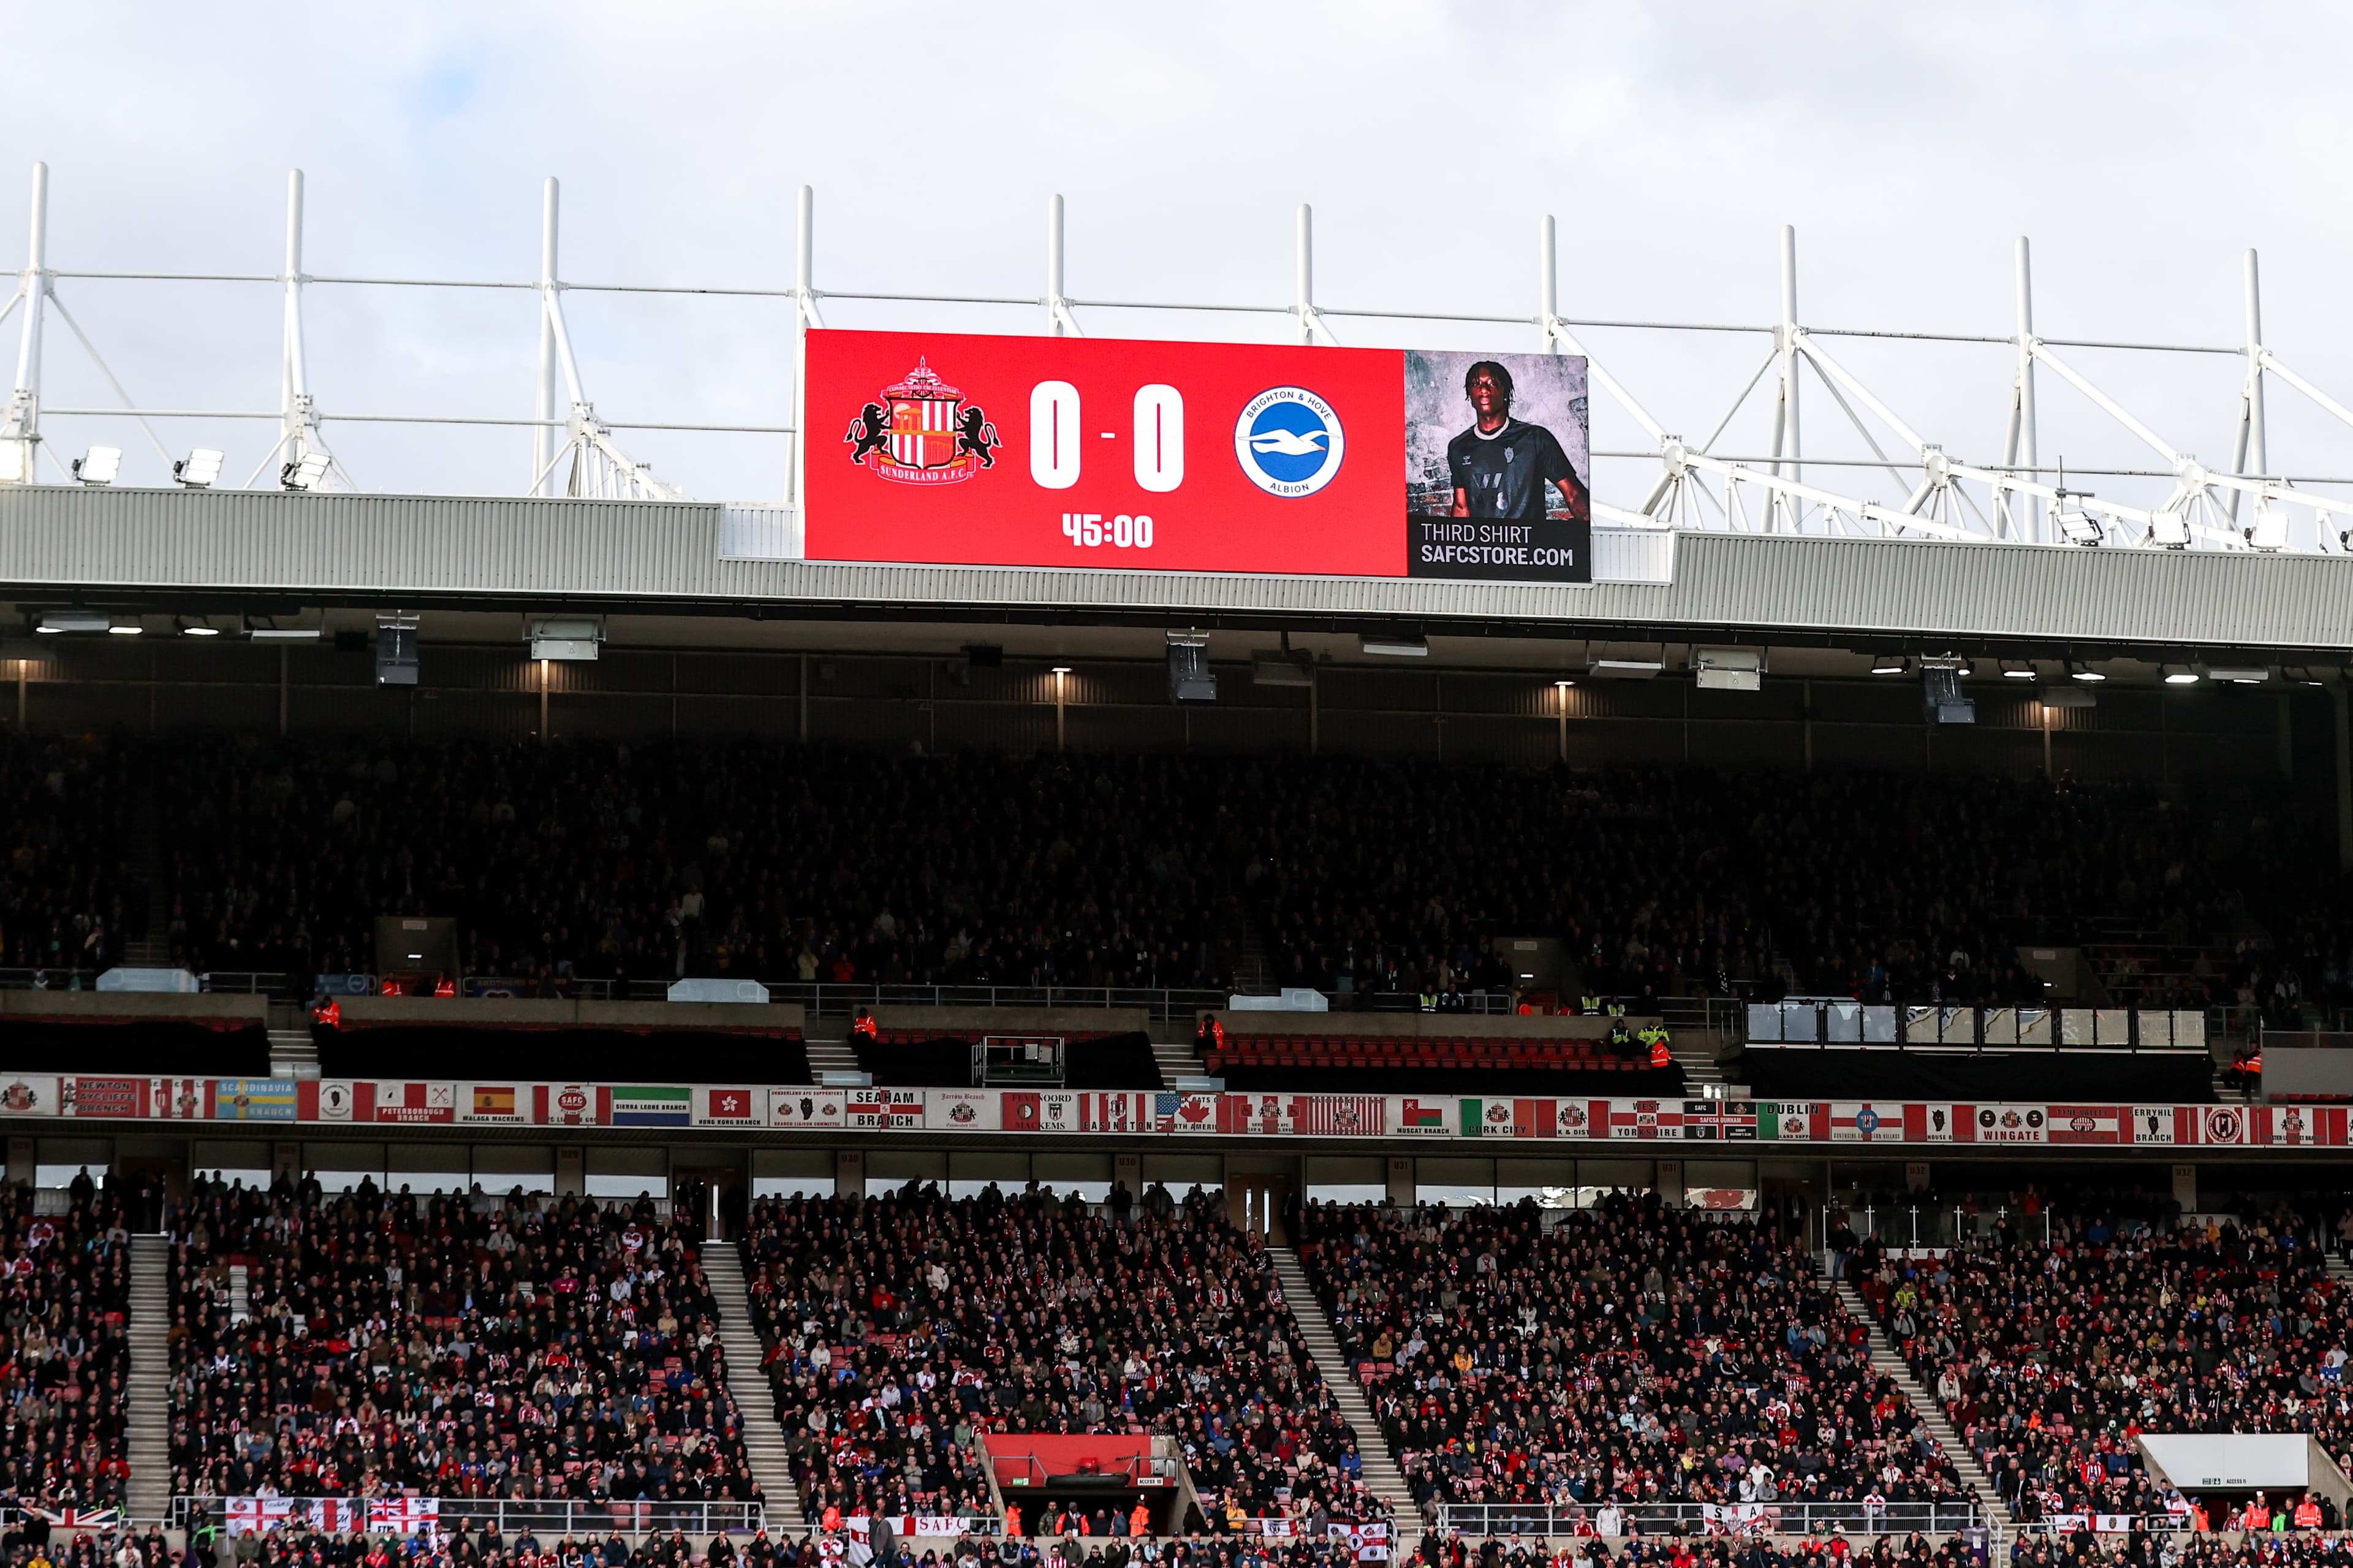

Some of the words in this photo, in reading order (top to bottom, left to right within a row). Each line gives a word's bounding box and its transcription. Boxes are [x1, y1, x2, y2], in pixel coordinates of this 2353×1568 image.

[1246, 391, 1294, 418] BRIGHTON
[1308, 396, 1332, 420] HOVE
[1029, 381, 1081, 490] 0
[1134, 383, 1184, 493] 0
[881, 464, 939, 481] SUNDERLAND
[942, 468, 966, 481] A.F.C.
[1270, 482, 1309, 493] ALBION
[1062, 513, 1153, 548] 45:00
[1421, 523, 1475, 542] THIRD
[1480, 525, 1532, 543] SHIRT
[1421, 545, 1574, 566] SAFCSTORE.COM
[79, 1081, 130, 1090] NEWTON
[222, 1082, 292, 1092] SCANDINAVIA
[79, 1093, 135, 1102] AYCLIFFE
[856, 1092, 914, 1103] SEAHAM
[78, 1104, 128, 1113] BRANCH
[1767, 1105, 1819, 1115] DUBLIN
[858, 1115, 913, 1126] BRANCH
[1618, 1128, 1677, 1137] YORKSHIRE
[1984, 1131, 2040, 1140] WINGATE
[842, 1154, 858, 1162] U30
[1119, 1157, 1136, 1166] U30
[1394, 1161, 1408, 1170] U31
[1662, 1164, 1677, 1172] U31
[919, 1517, 966, 1531] SAFC
